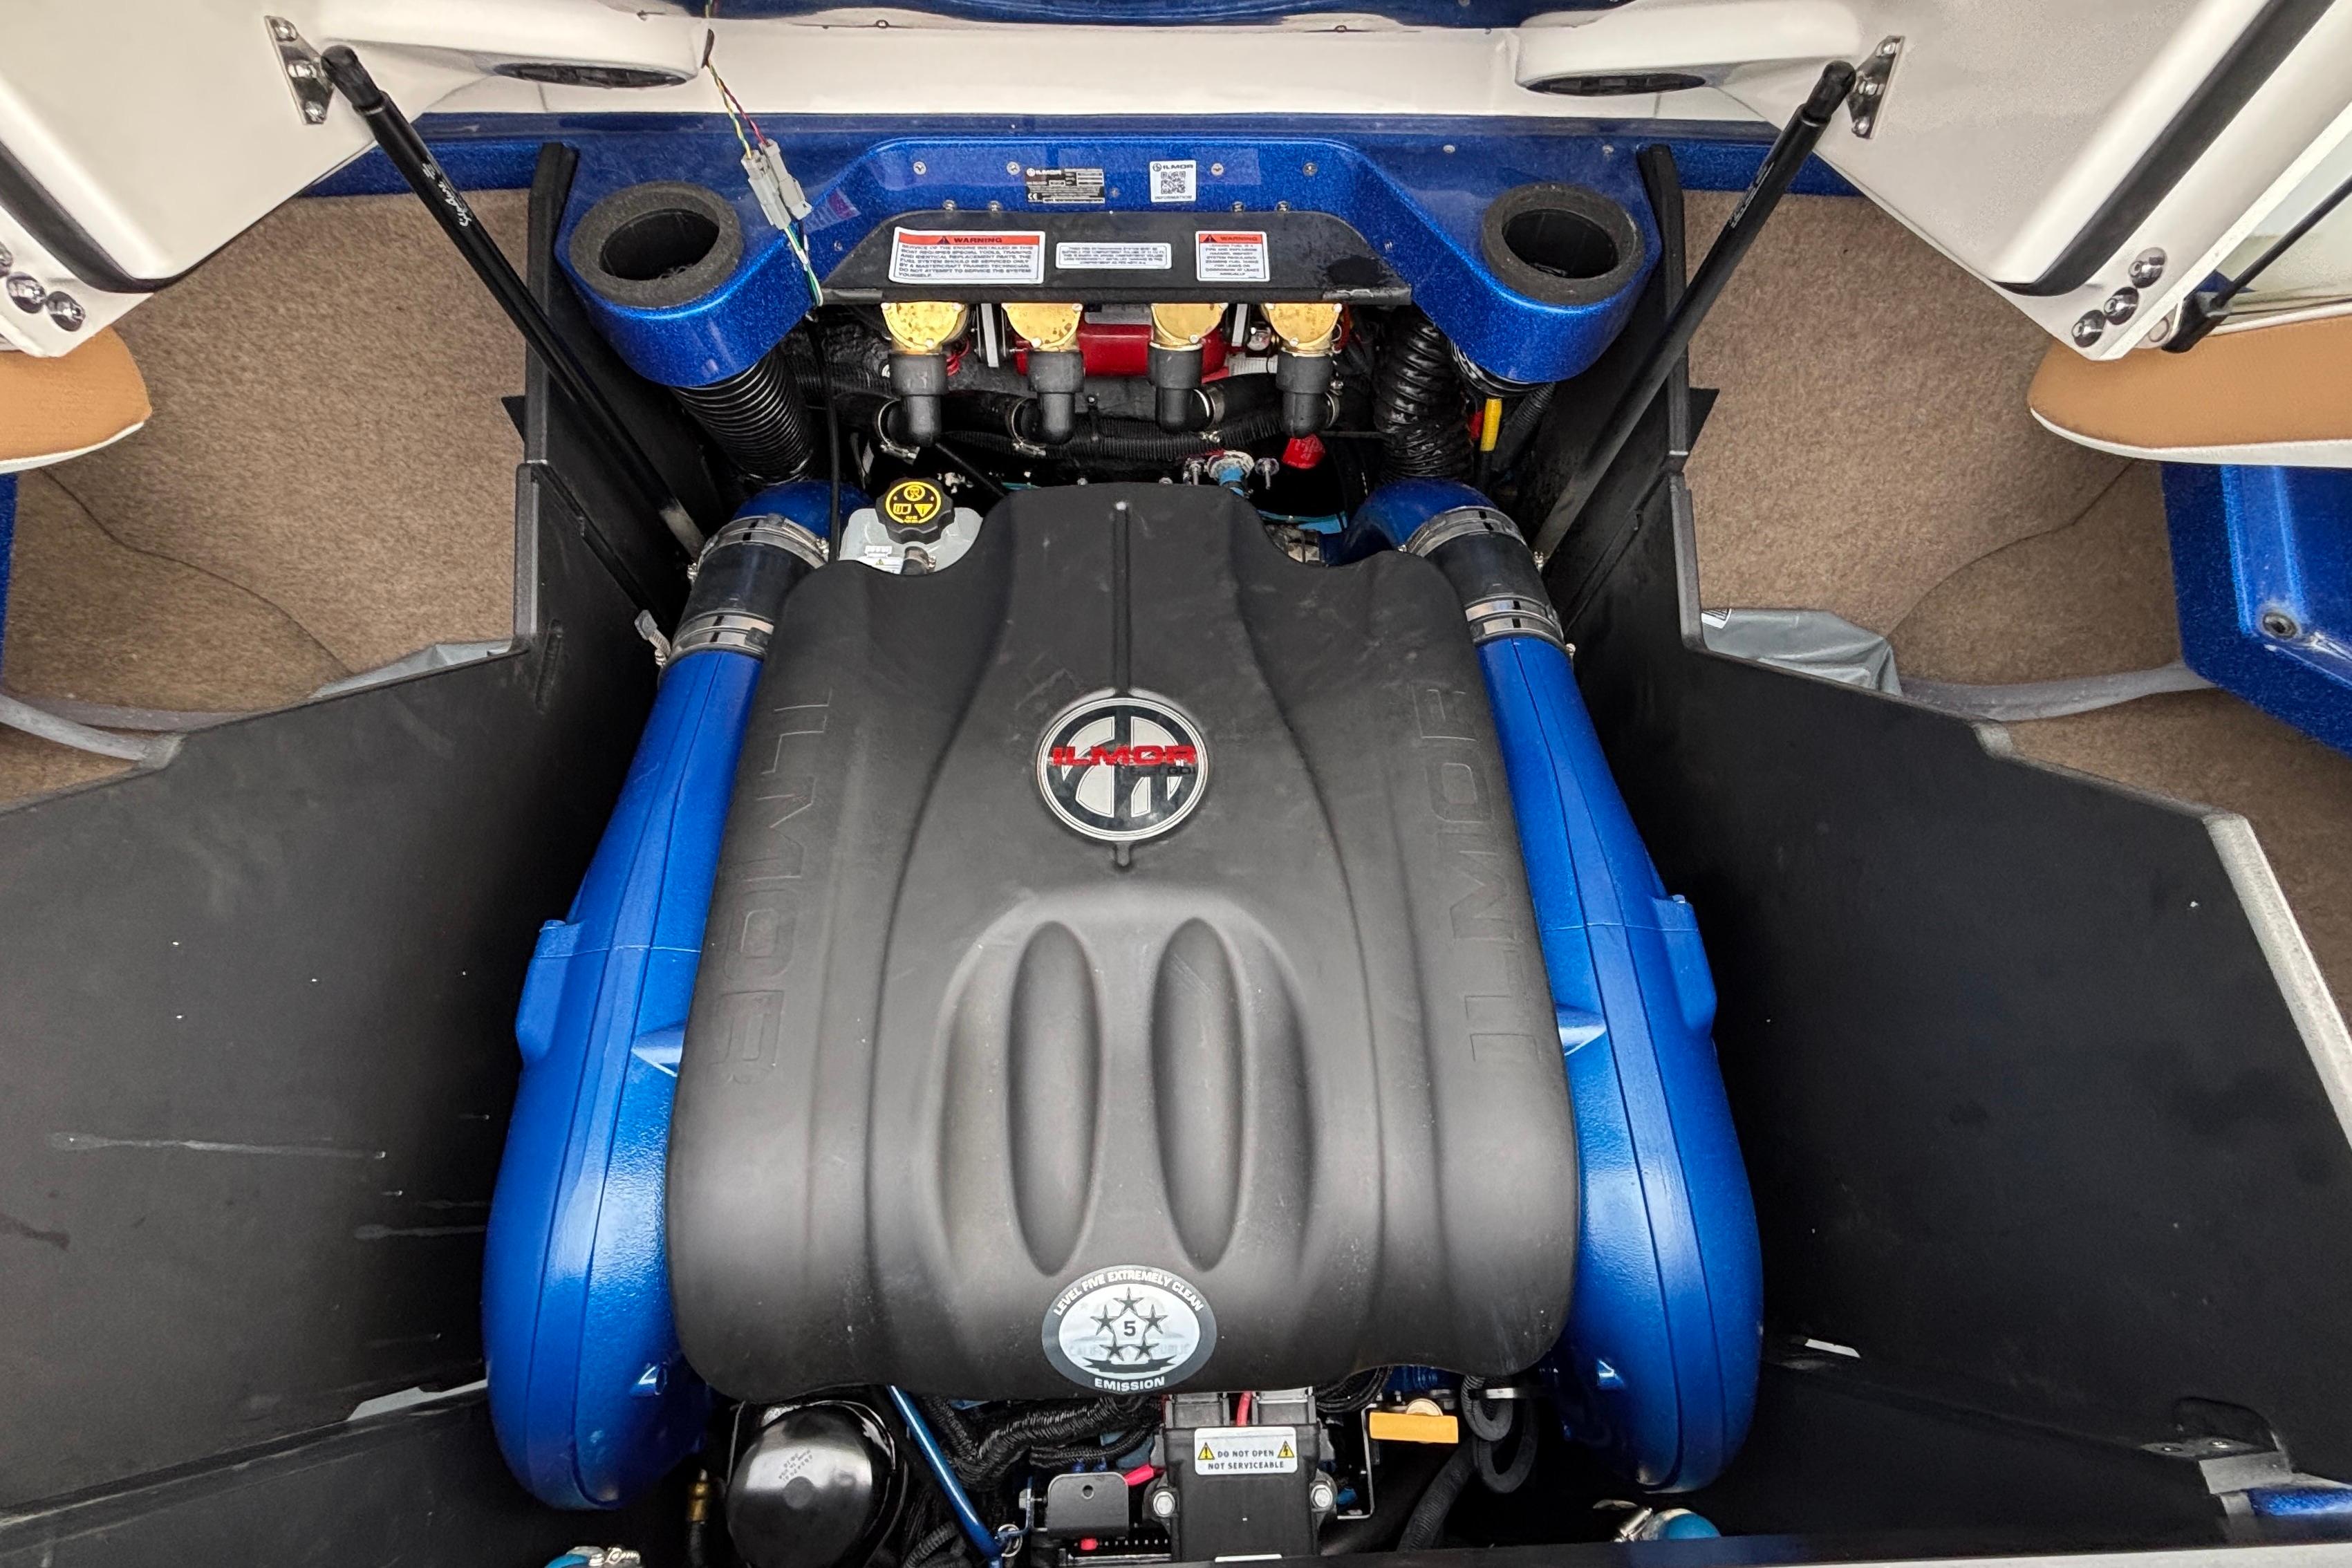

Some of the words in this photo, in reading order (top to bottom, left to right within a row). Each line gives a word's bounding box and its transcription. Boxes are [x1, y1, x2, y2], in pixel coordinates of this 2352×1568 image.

[1051, 744, 1197, 767] ILMOR
[1053, 1287, 1083, 1316] LEVEL
[1081, 1275, 1106, 1291] FIVE
[1107, 1269, 1172, 1287] EXTREMELY
[1172, 1281, 1204, 1312] CLEAN
[1123, 1320, 1136, 1336] 5
[1094, 1376, 1165, 1392] EMISSION
[1228, 1461, 1284, 1470] SERVICEABLE
